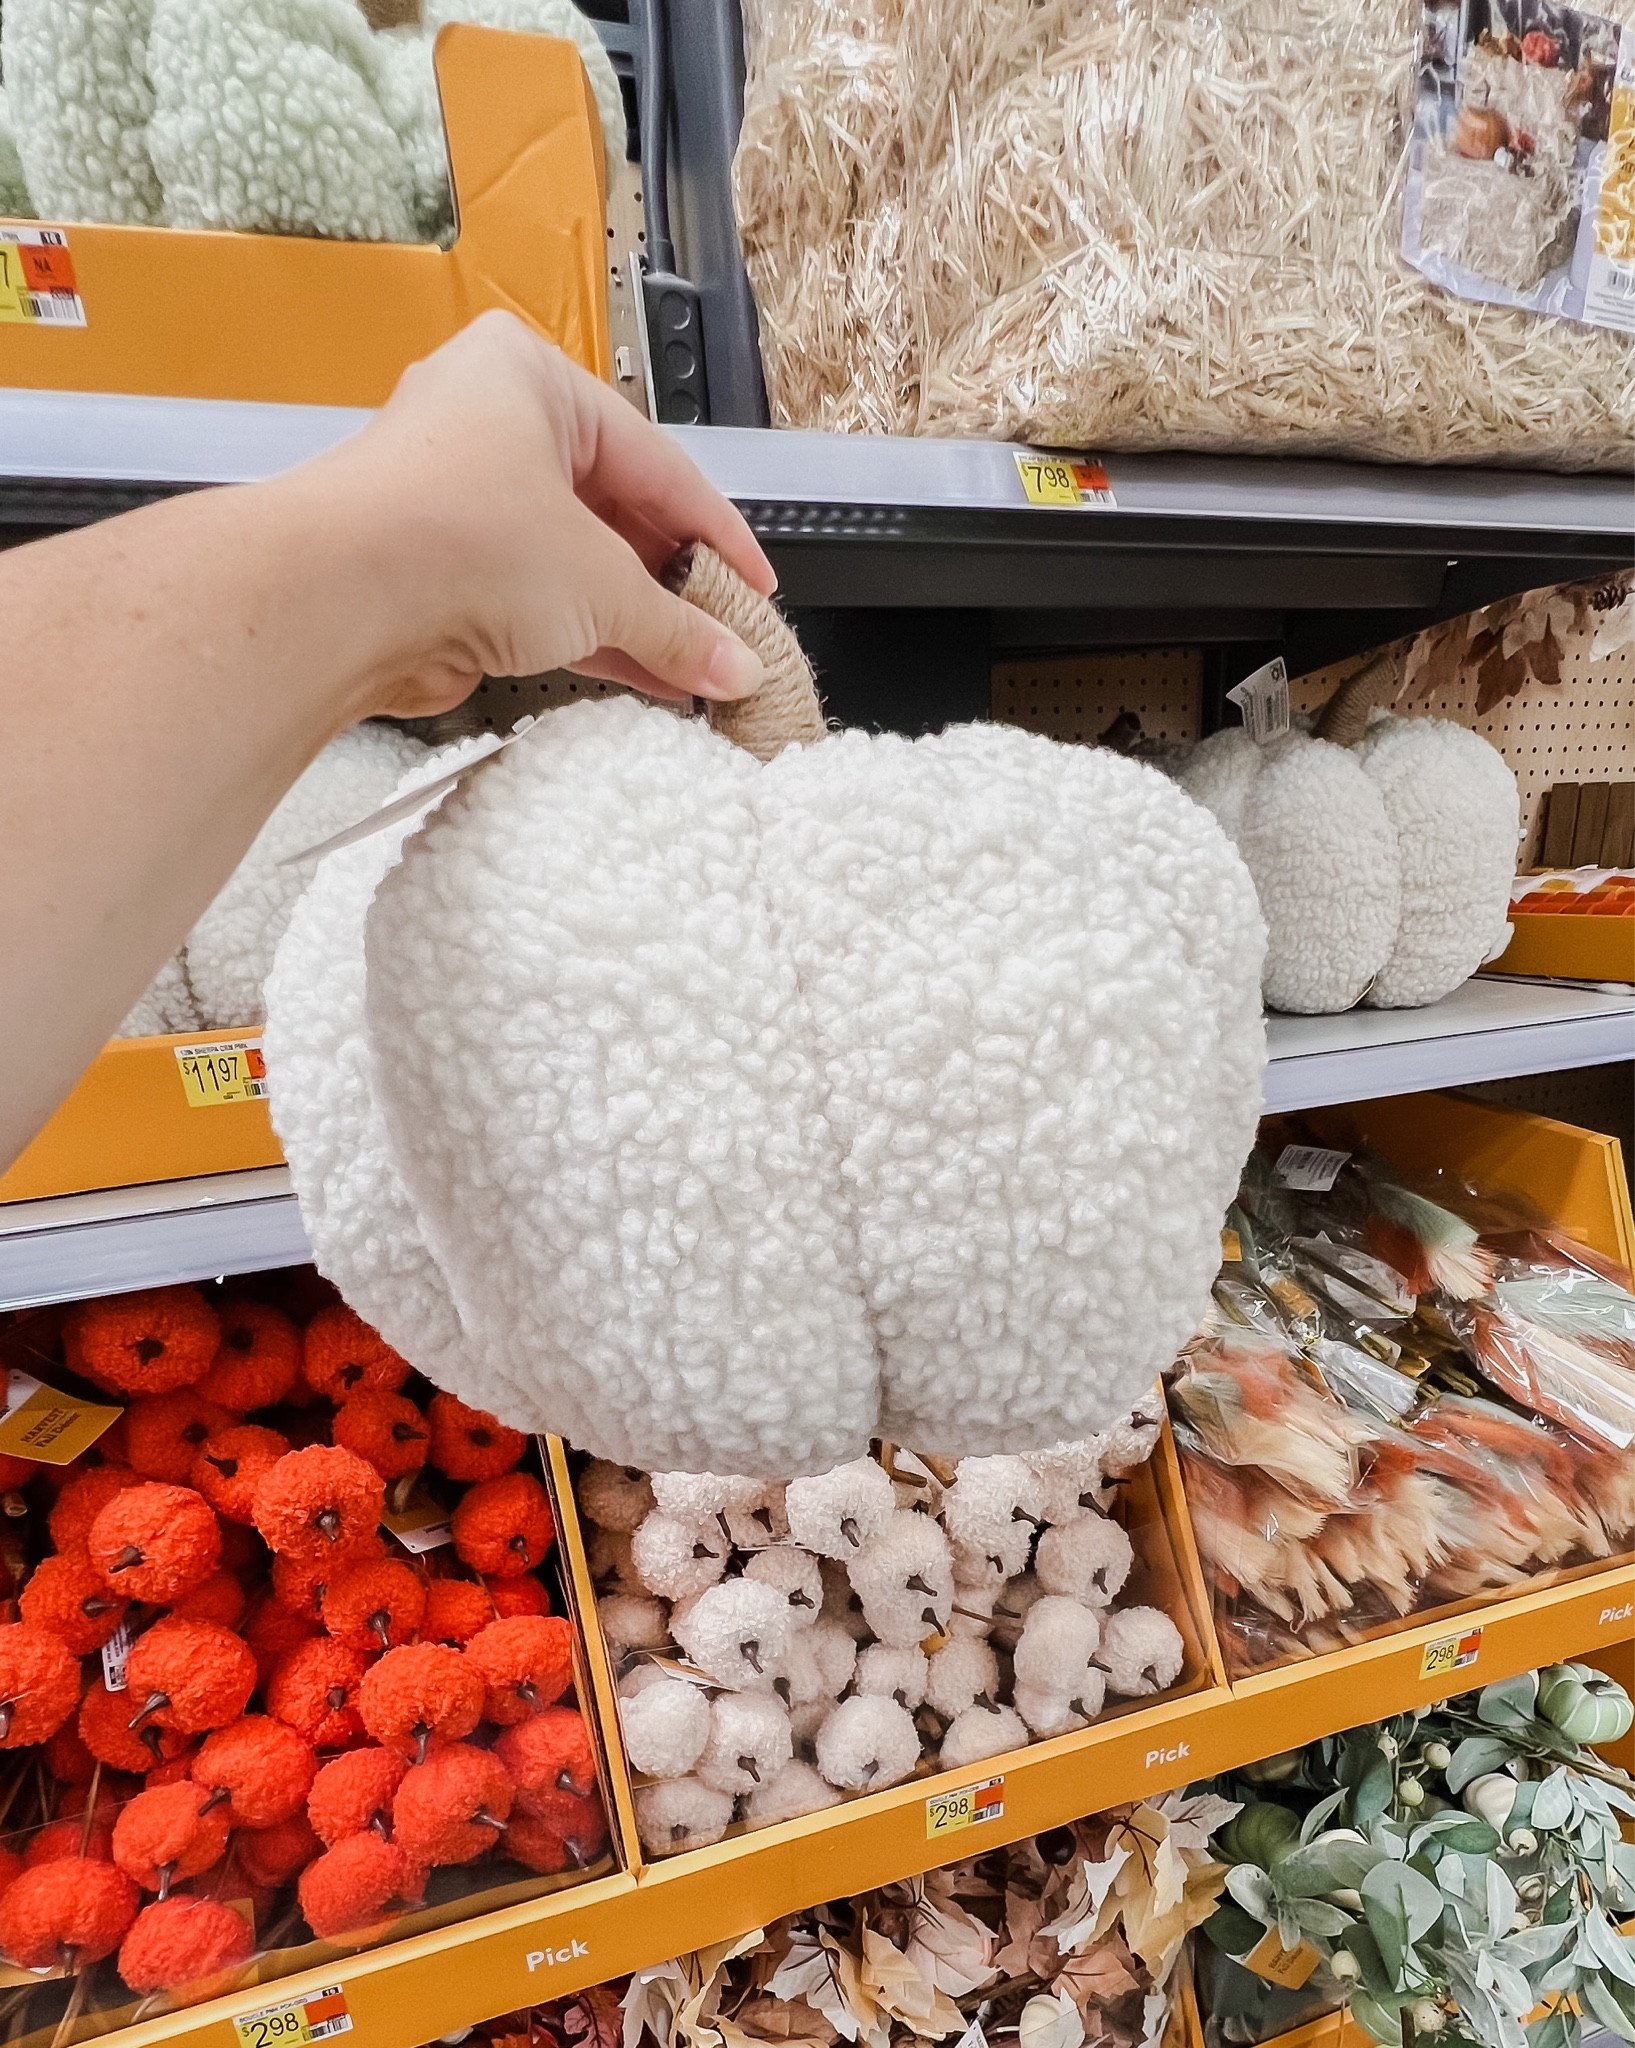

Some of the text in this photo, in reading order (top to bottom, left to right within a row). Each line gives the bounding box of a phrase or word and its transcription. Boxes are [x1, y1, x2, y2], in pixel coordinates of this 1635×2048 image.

[1598, 1602, 1634, 1625] Pick
[1145, 1741, 1191, 1769] Pick
[525, 1938, 590, 1972] Pick
